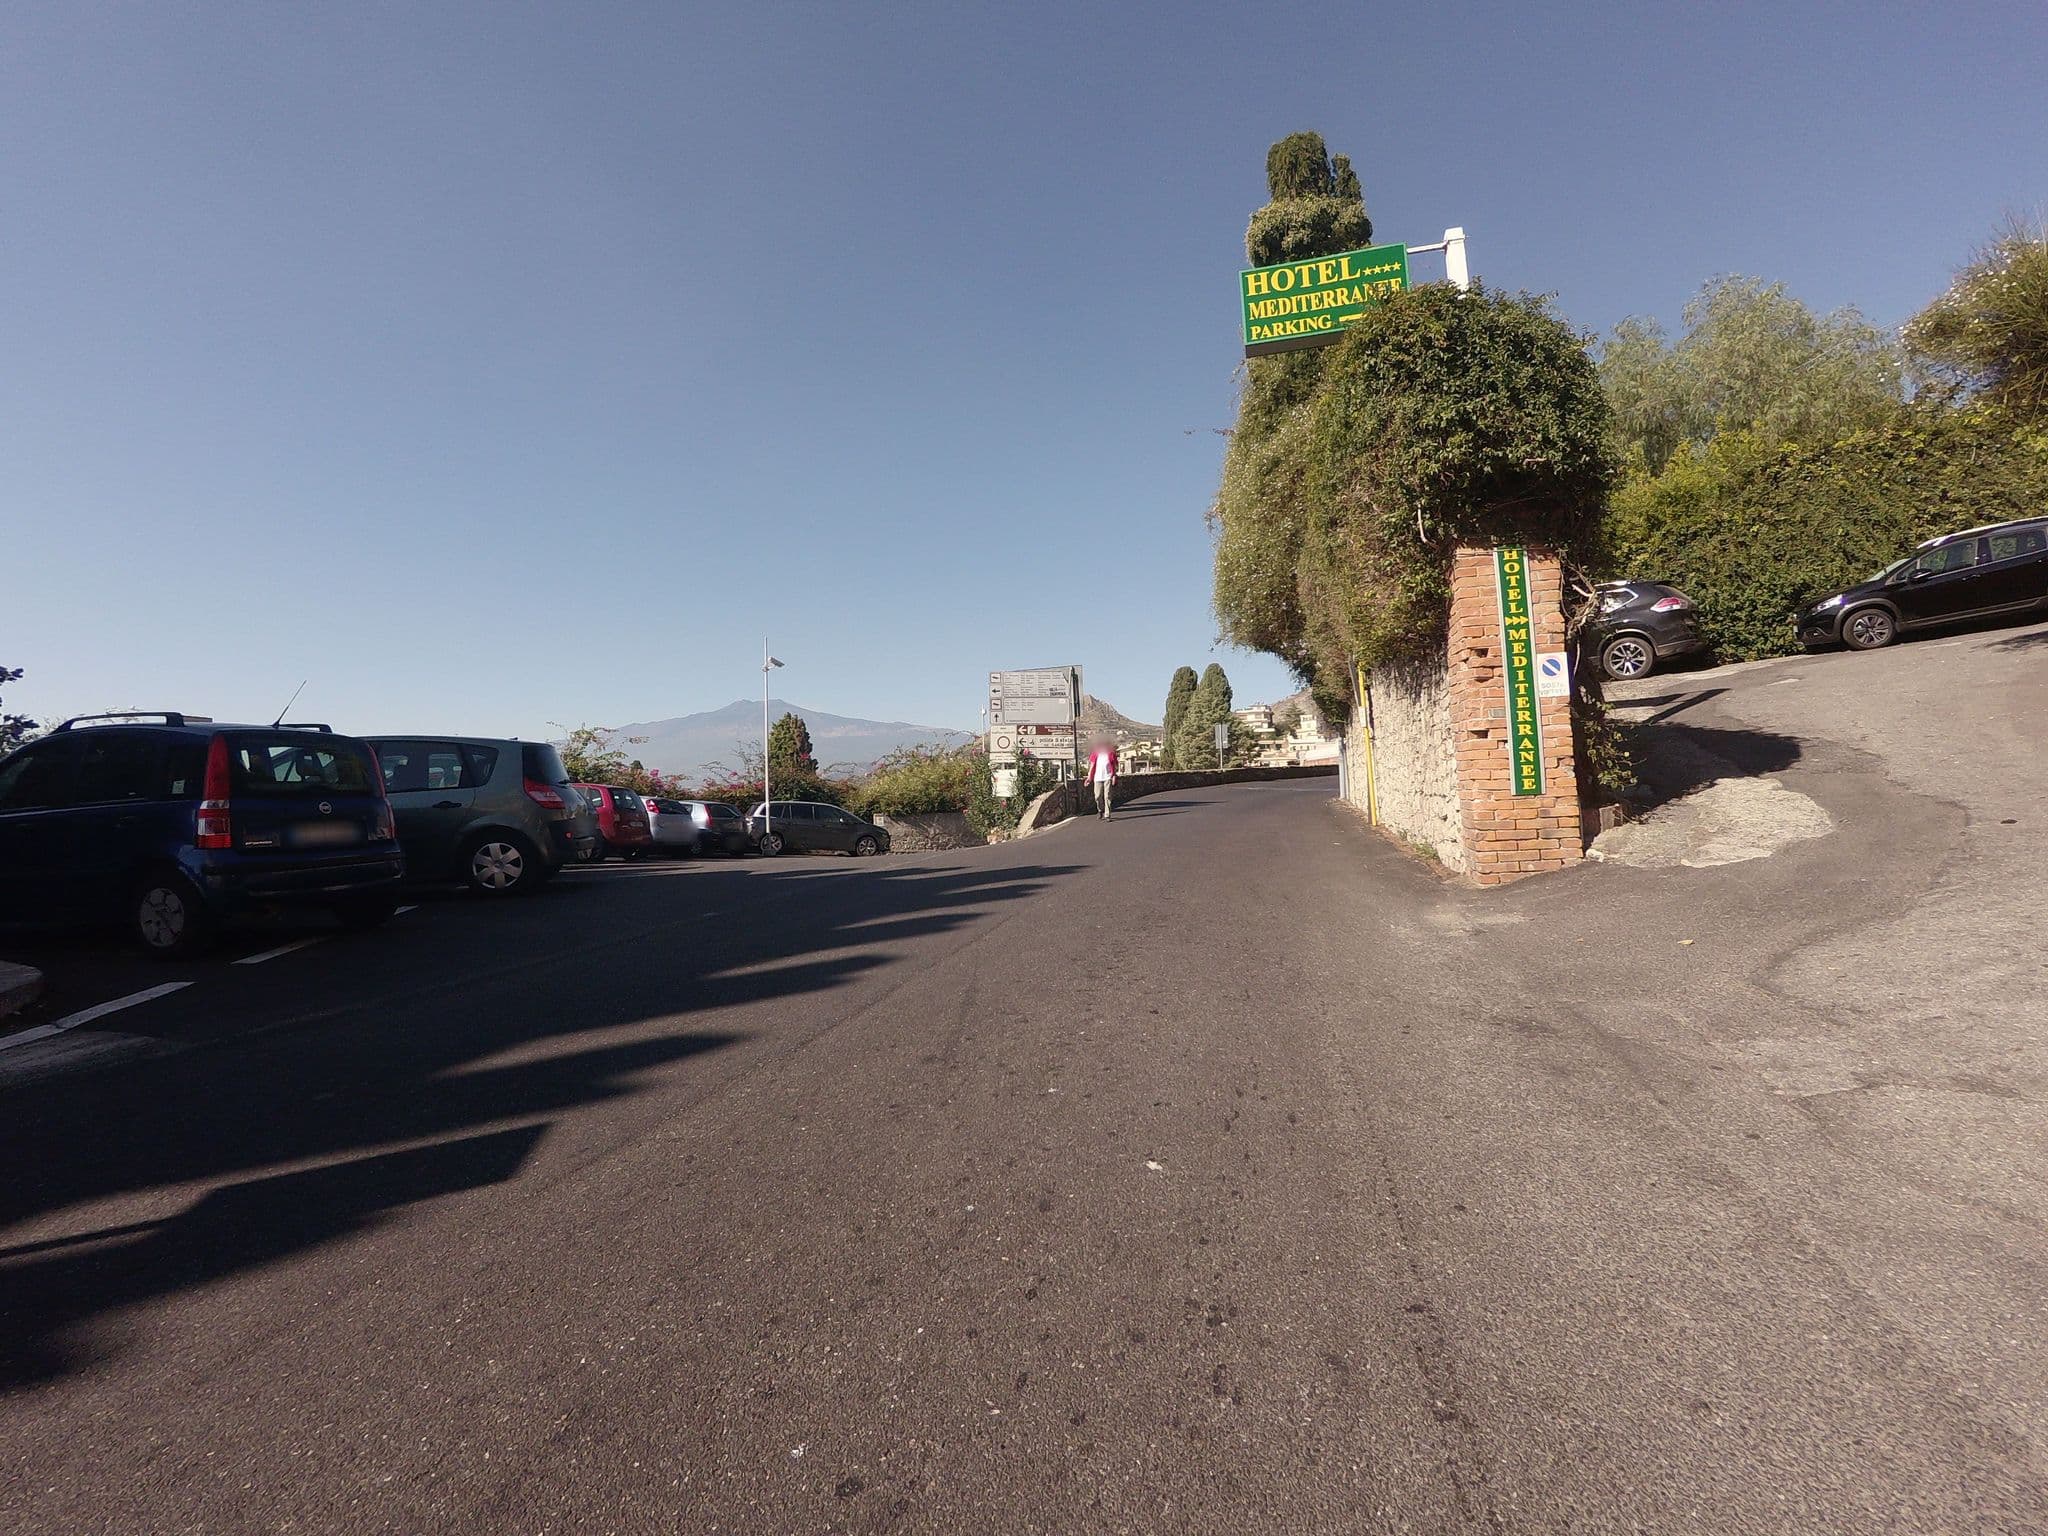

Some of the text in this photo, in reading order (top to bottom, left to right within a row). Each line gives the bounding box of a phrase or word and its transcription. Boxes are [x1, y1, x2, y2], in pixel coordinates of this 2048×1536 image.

[1246, 256, 1361, 297] HOTEL
[1250, 314, 1333, 340] PARKING
[1503, 549, 1537, 791] HOTEL MEDITERRANEE
